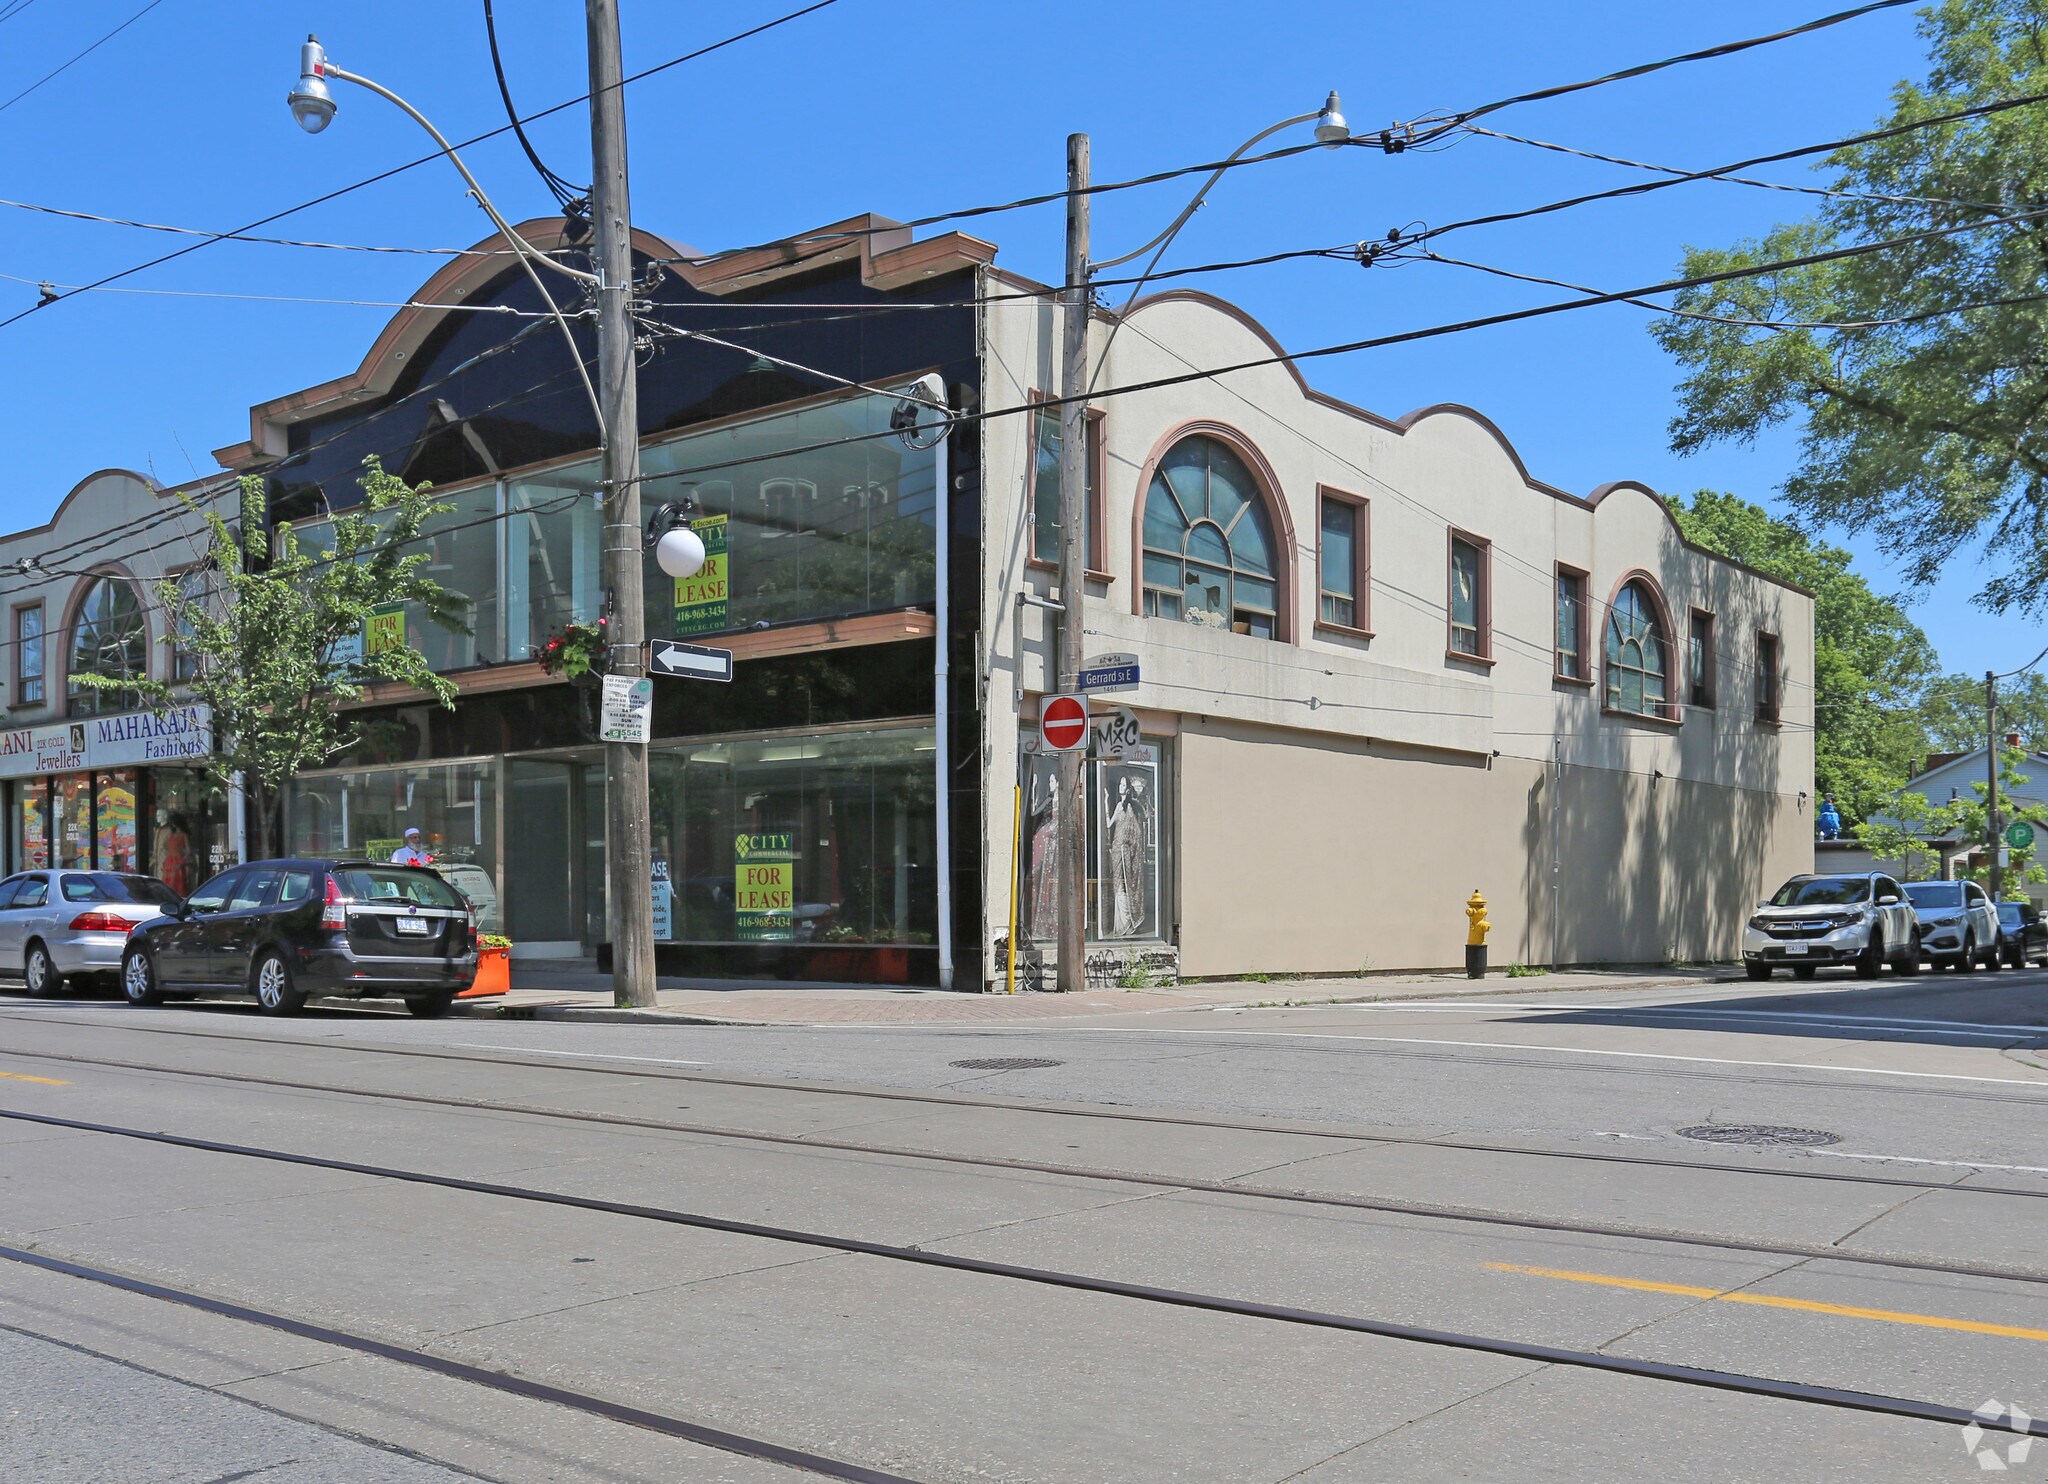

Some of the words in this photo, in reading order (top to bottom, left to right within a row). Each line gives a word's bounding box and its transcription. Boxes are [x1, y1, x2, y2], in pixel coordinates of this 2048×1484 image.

[700, 526, 725, 541] ITY
[695, 559, 717, 580] OR
[677, 580, 727, 604] LEASE
[676, 605, 726, 622] 416-968-3434
[373, 616, 397, 633] FOR
[1086, 671, 1117, 685] Gerrard
[1118, 672, 1125, 681] St
[1126, 669, 1131, 680] E
[98, 707, 202, 743] MAHARAJA
[0, 731, 33, 756] ANI
[37, 739, 47, 749] 22K
[48, 737, 66, 748] GOLD
[145, 737, 202, 759] Fashions
[36, 750, 81, 770] Jewellers
[67, 823, 78, 832] 22K
[66, 832, 80, 841] GOLD
[750, 835, 790, 849] CITY
[209, 854, 225, 863] GOLD
[746, 867, 782, 886] FOR
[737, 890, 791, 909] LEASE
[737, 916, 791, 928] 416-968-3434
